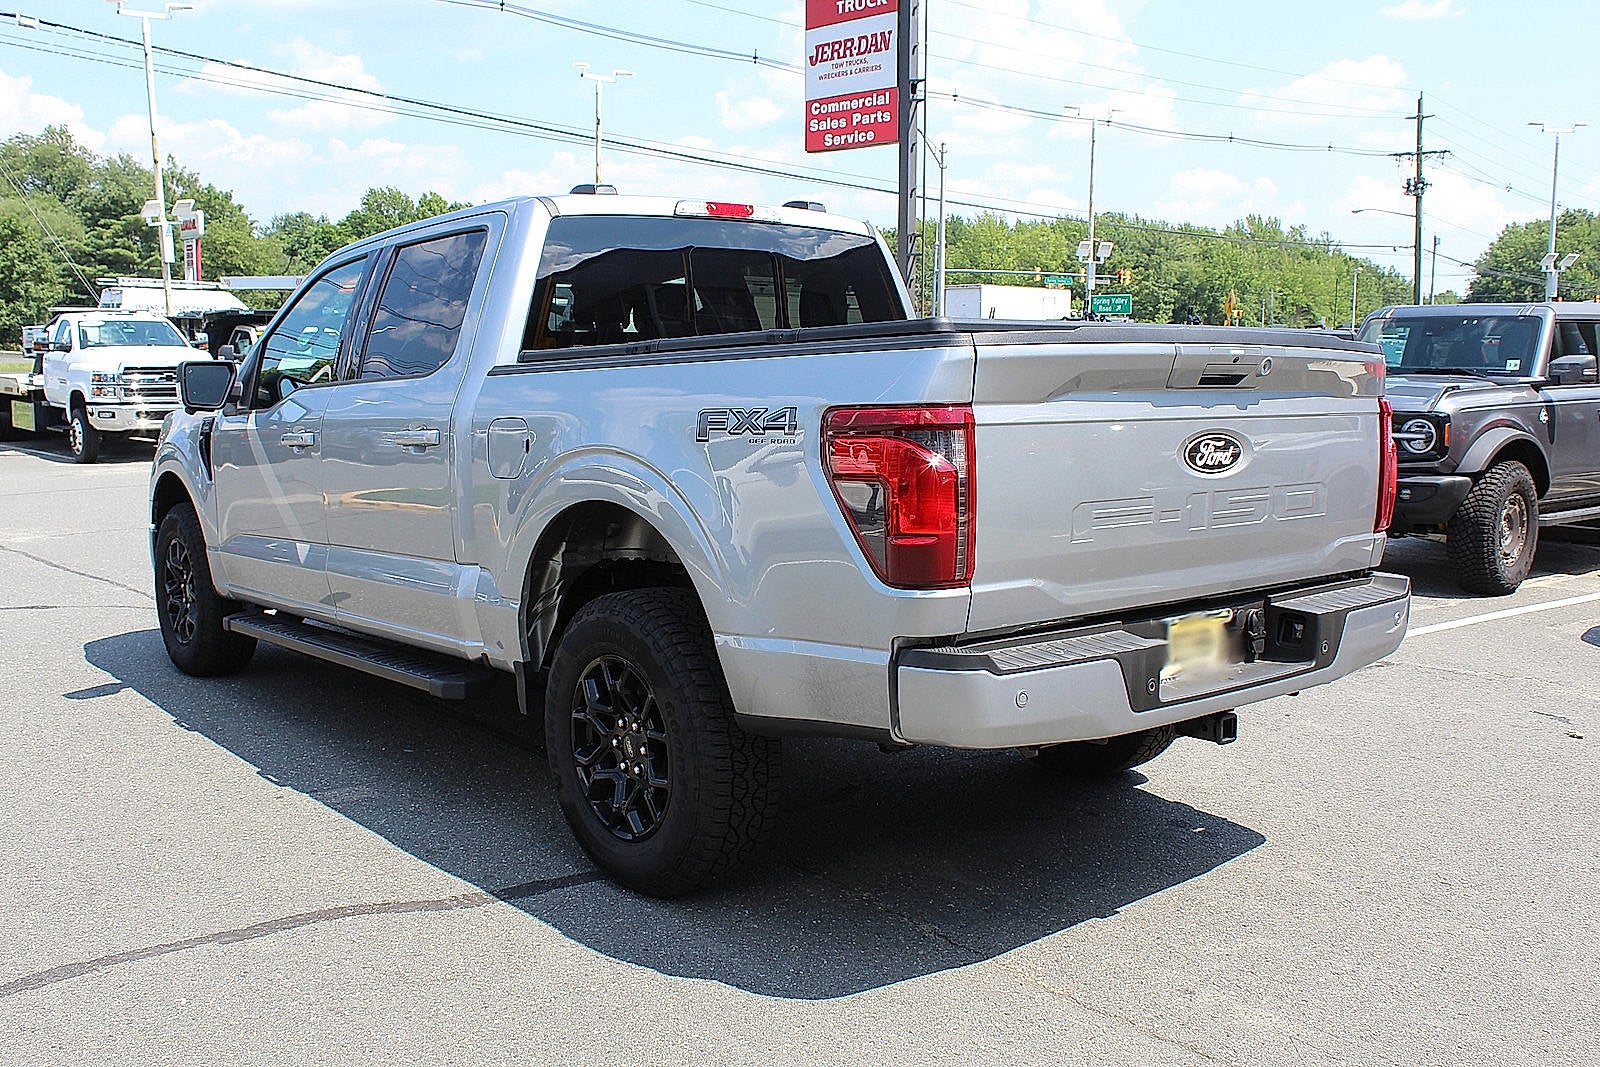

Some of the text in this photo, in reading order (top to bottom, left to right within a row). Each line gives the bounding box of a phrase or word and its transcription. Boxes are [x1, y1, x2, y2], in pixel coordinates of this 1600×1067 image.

[818, 70, 849, 81] WRECKERS
[854, 64, 882, 75] CARRIERS
[831, 57, 869, 70] TOW TRUCKS,
[811, 92, 890, 115] Commercial
[809, 110, 891, 132] Sales Parts
[824, 130, 875, 147] Service
[696, 406, 797, 442] FX4
[1195, 438, 1235, 467] Ford
[1070, 480, 1328, 545] F-150
